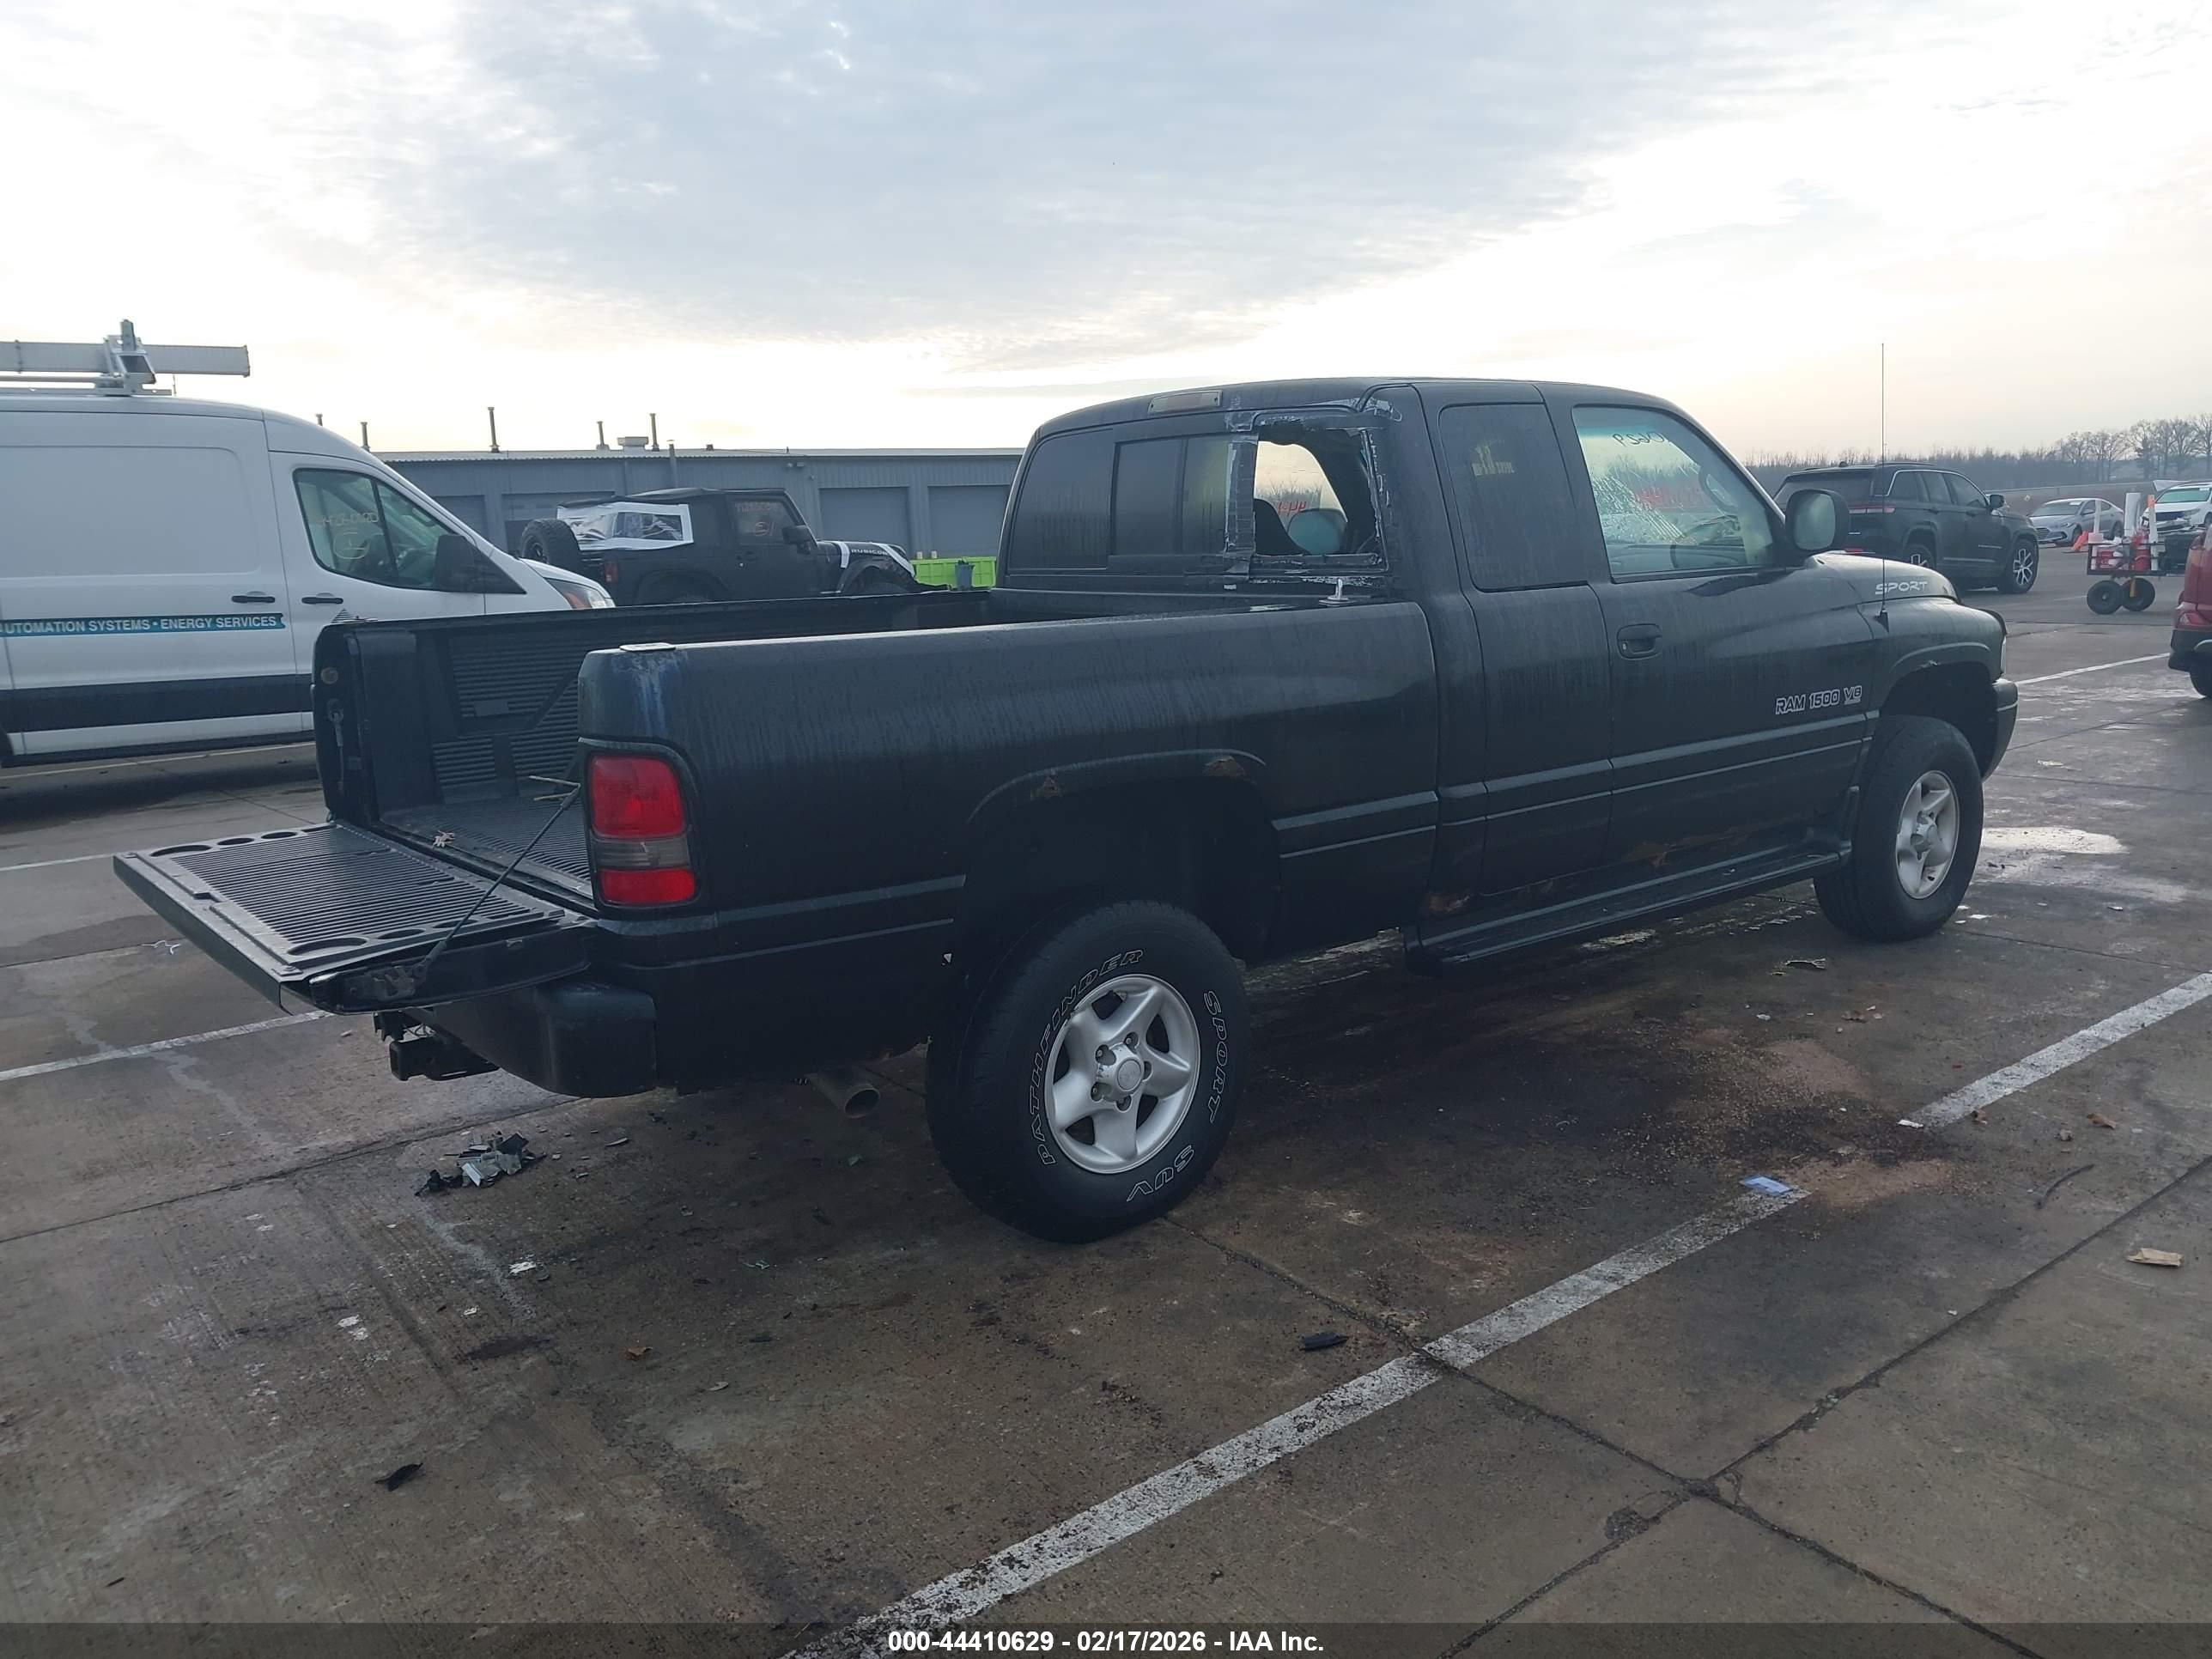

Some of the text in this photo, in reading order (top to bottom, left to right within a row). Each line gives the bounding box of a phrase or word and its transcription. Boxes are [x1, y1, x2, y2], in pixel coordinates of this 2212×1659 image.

[1875, 580, 1929, 595] SPORT
[0, 616, 276, 634] UTOMATION SYSTEMS ENERGY SERVICES
[1775, 685, 1863, 715] RAM 1500 V8
[1030, 950, 1143, 1165] PATHFINDER
[1204, 990, 1228, 1124] SPORT
[1127, 1145, 1194, 1202] SUV
